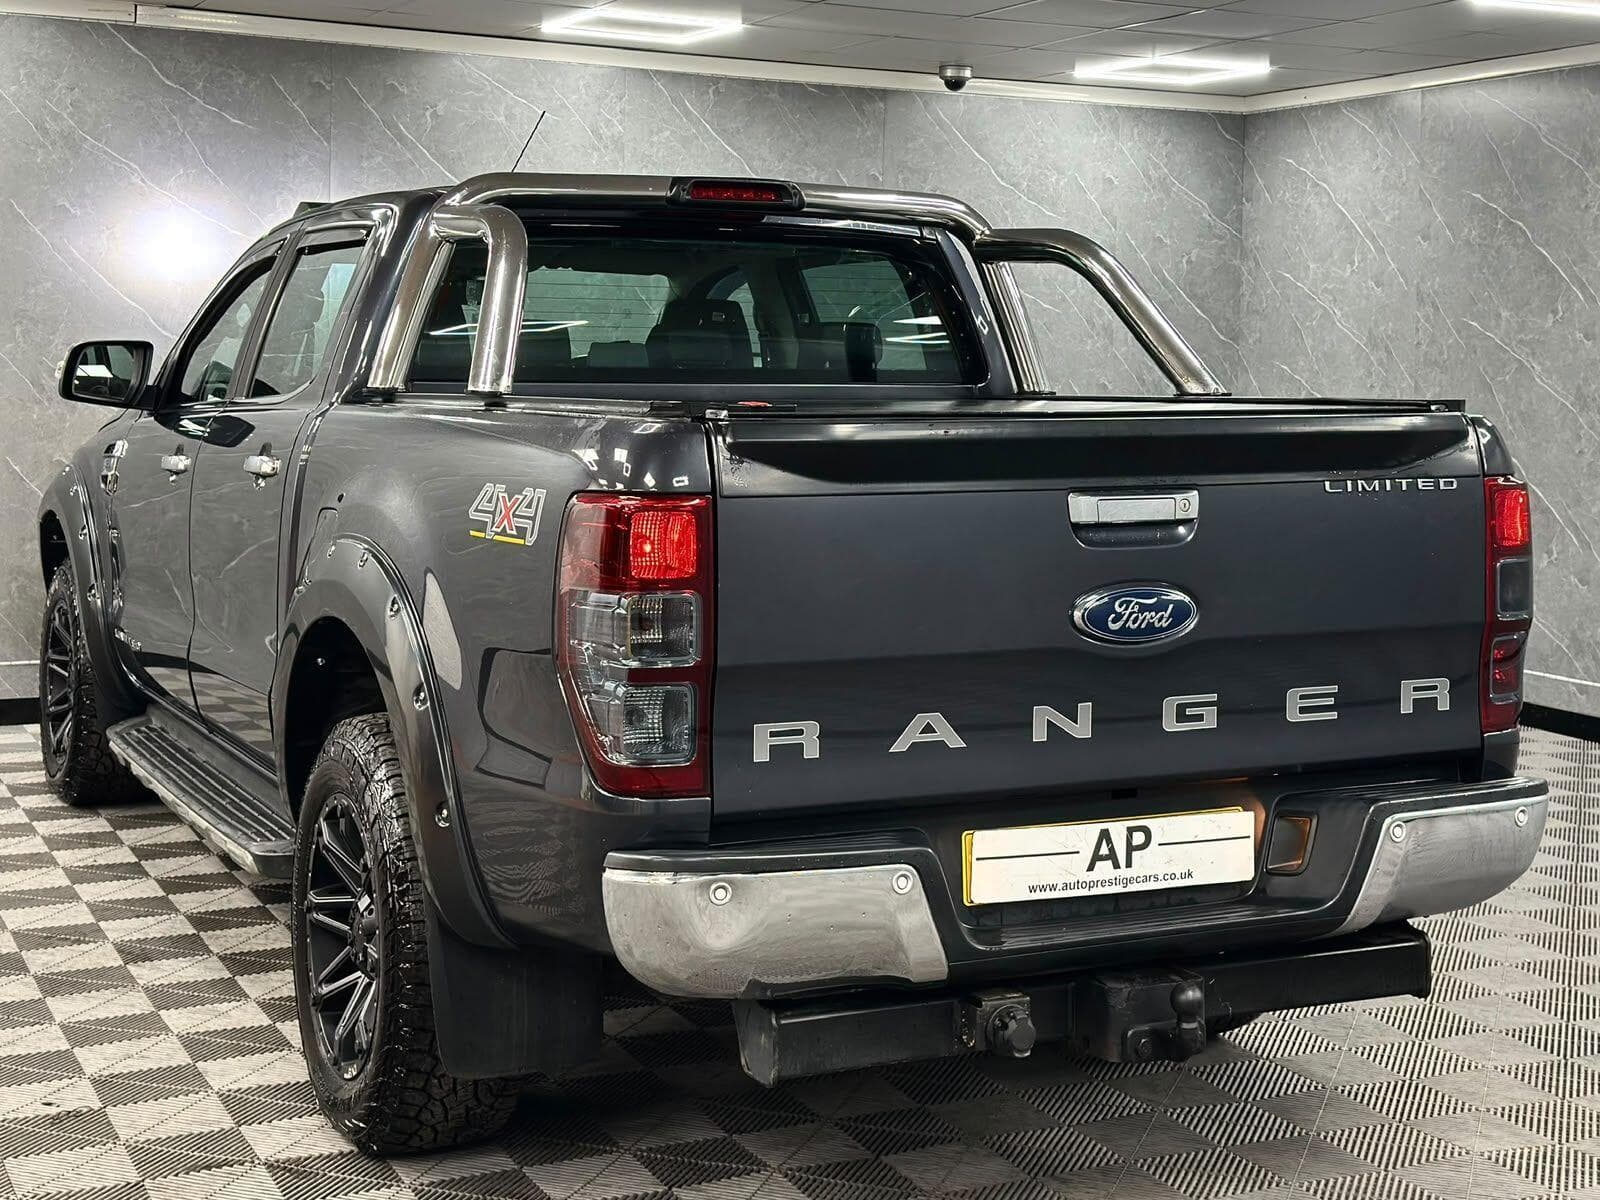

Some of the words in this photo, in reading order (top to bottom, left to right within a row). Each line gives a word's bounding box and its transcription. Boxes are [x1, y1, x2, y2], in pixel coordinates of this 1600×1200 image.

[1324, 478, 1458, 492] LIMITED
[1107, 597, 1175, 630] Ford
[752, 677, 1451, 763] RANGER
[1086, 824, 1153, 873] AP
[1028, 868, 1194, 894] www.autoprestigecars.co.uk
